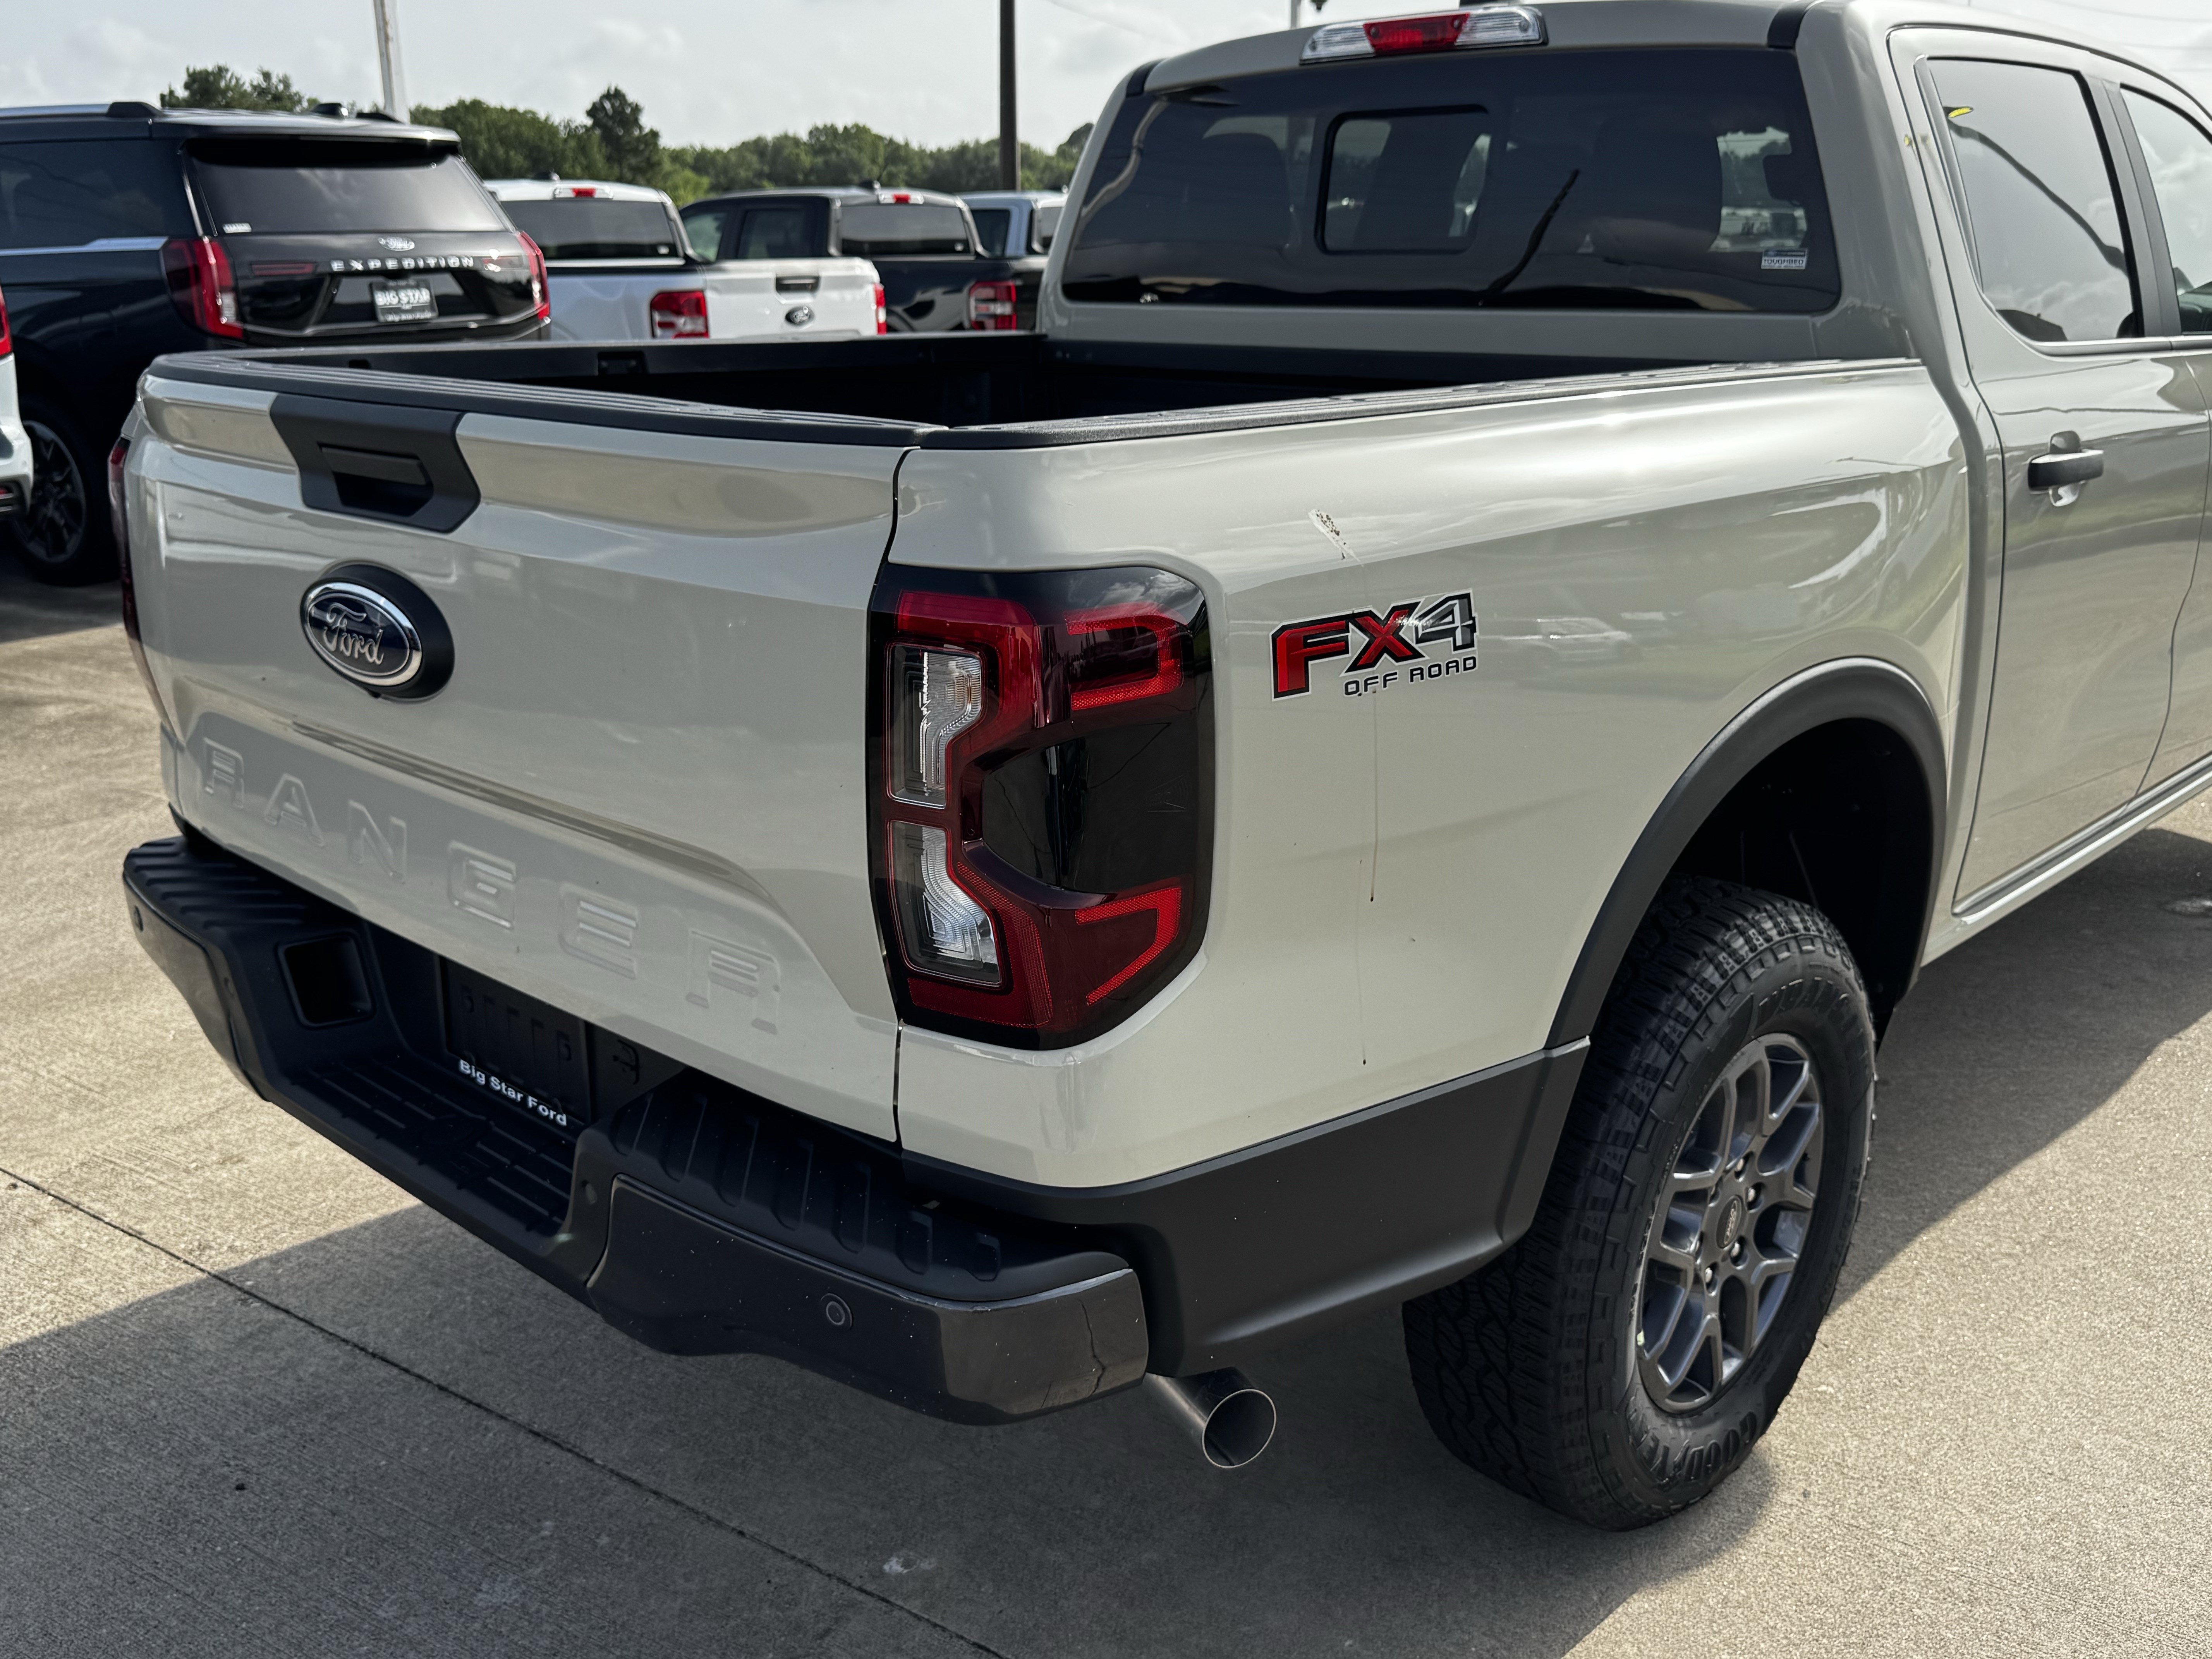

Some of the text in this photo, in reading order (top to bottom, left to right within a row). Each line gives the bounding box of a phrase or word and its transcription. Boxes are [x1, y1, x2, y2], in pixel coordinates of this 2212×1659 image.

[330, 257, 474, 271] EXPEDITION
[374, 288, 431, 305] BIG STAR
[323, 603, 384, 665] Ford
[1271, 589, 1479, 701] FX4
[1345, 656, 1477, 696] OFF ROAD
[203, 737, 780, 1035] RANGER
[459, 1059, 567, 1126] Big Star Ford
